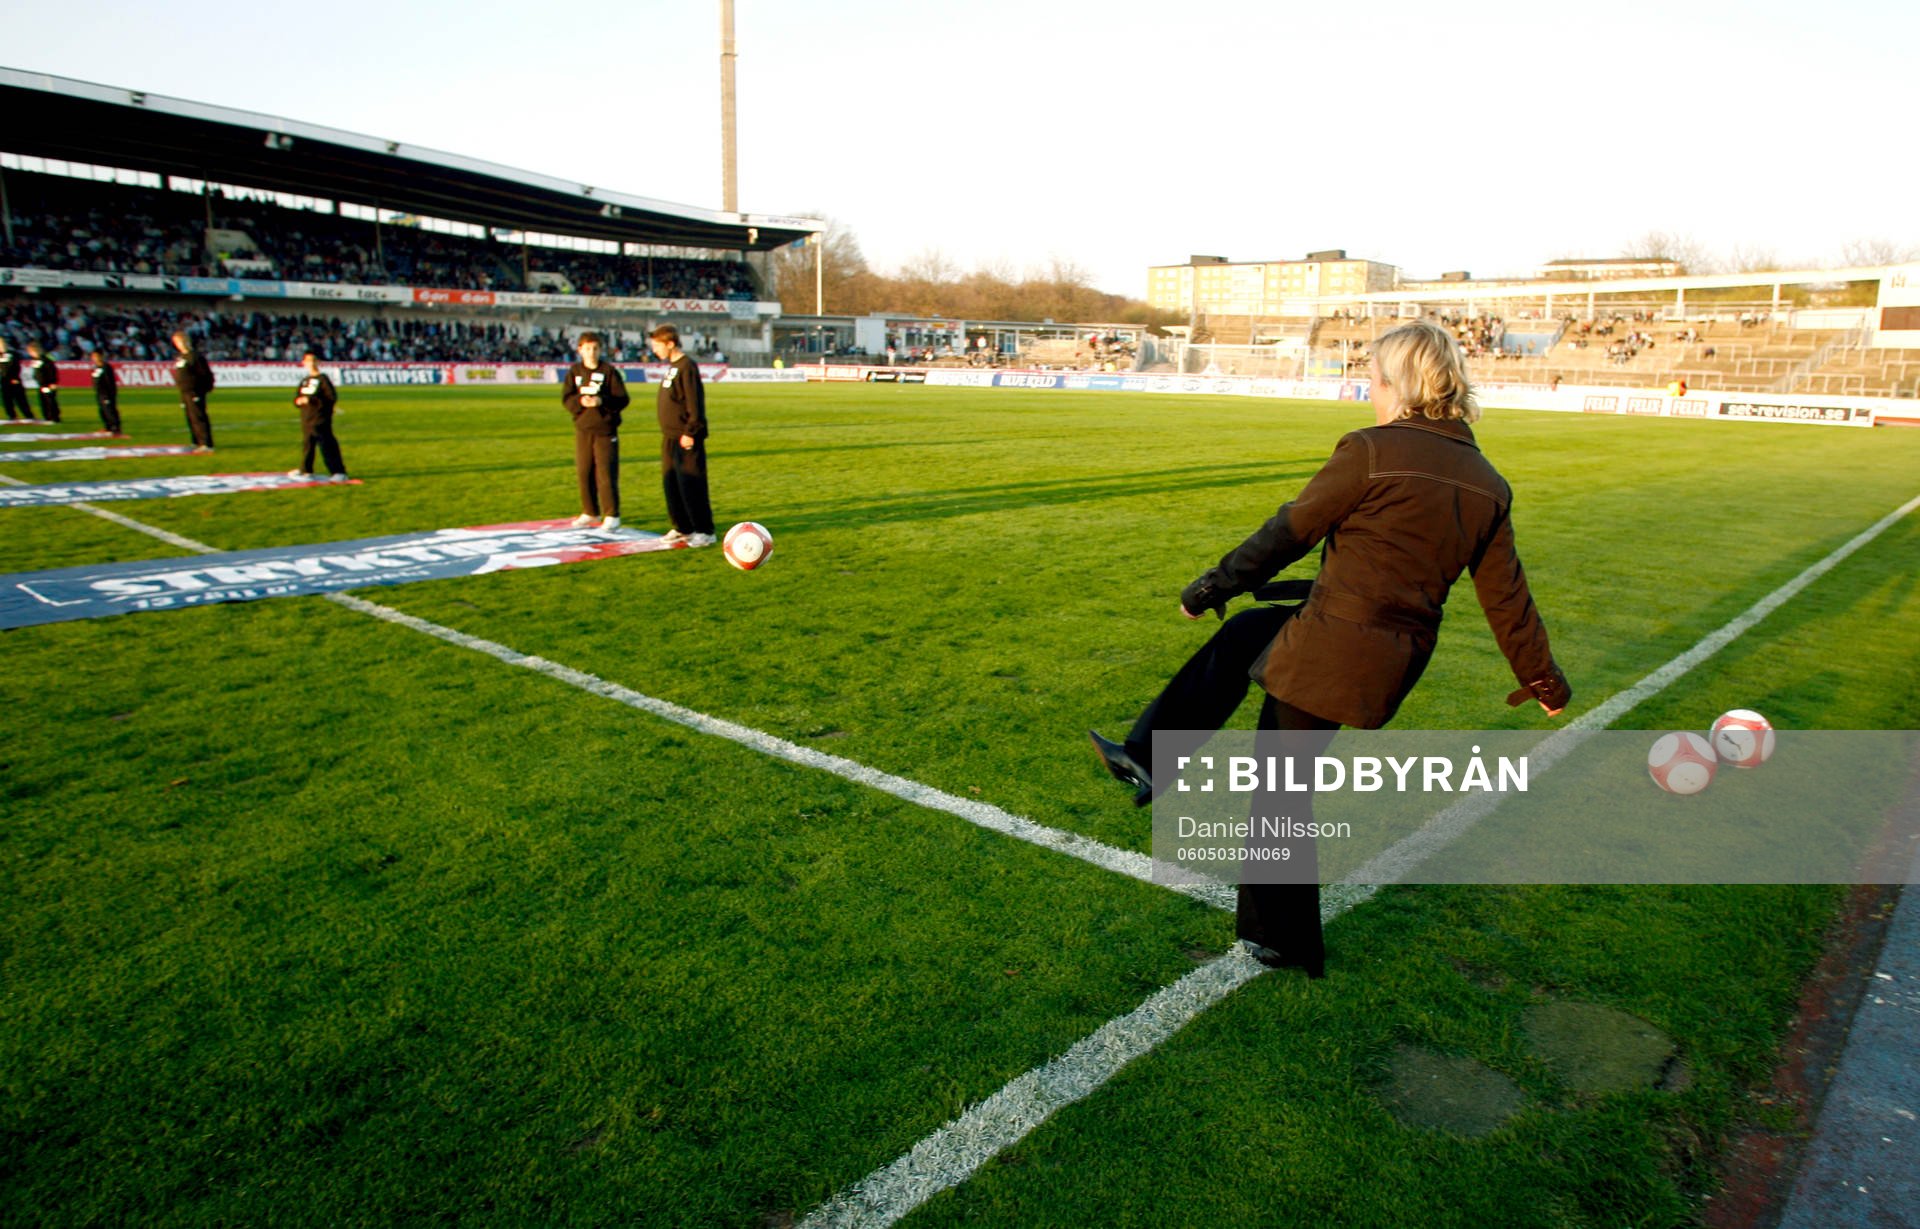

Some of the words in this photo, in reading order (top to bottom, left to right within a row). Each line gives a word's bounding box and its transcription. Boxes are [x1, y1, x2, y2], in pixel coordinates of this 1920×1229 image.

[660, 299, 678, 310] ICA
[684, 300, 702, 311] ICA
[708, 300, 726, 312] ICA
[1672, 400, 1706, 415] FELIX
[1727, 403, 1844, 420] set-revision.se
